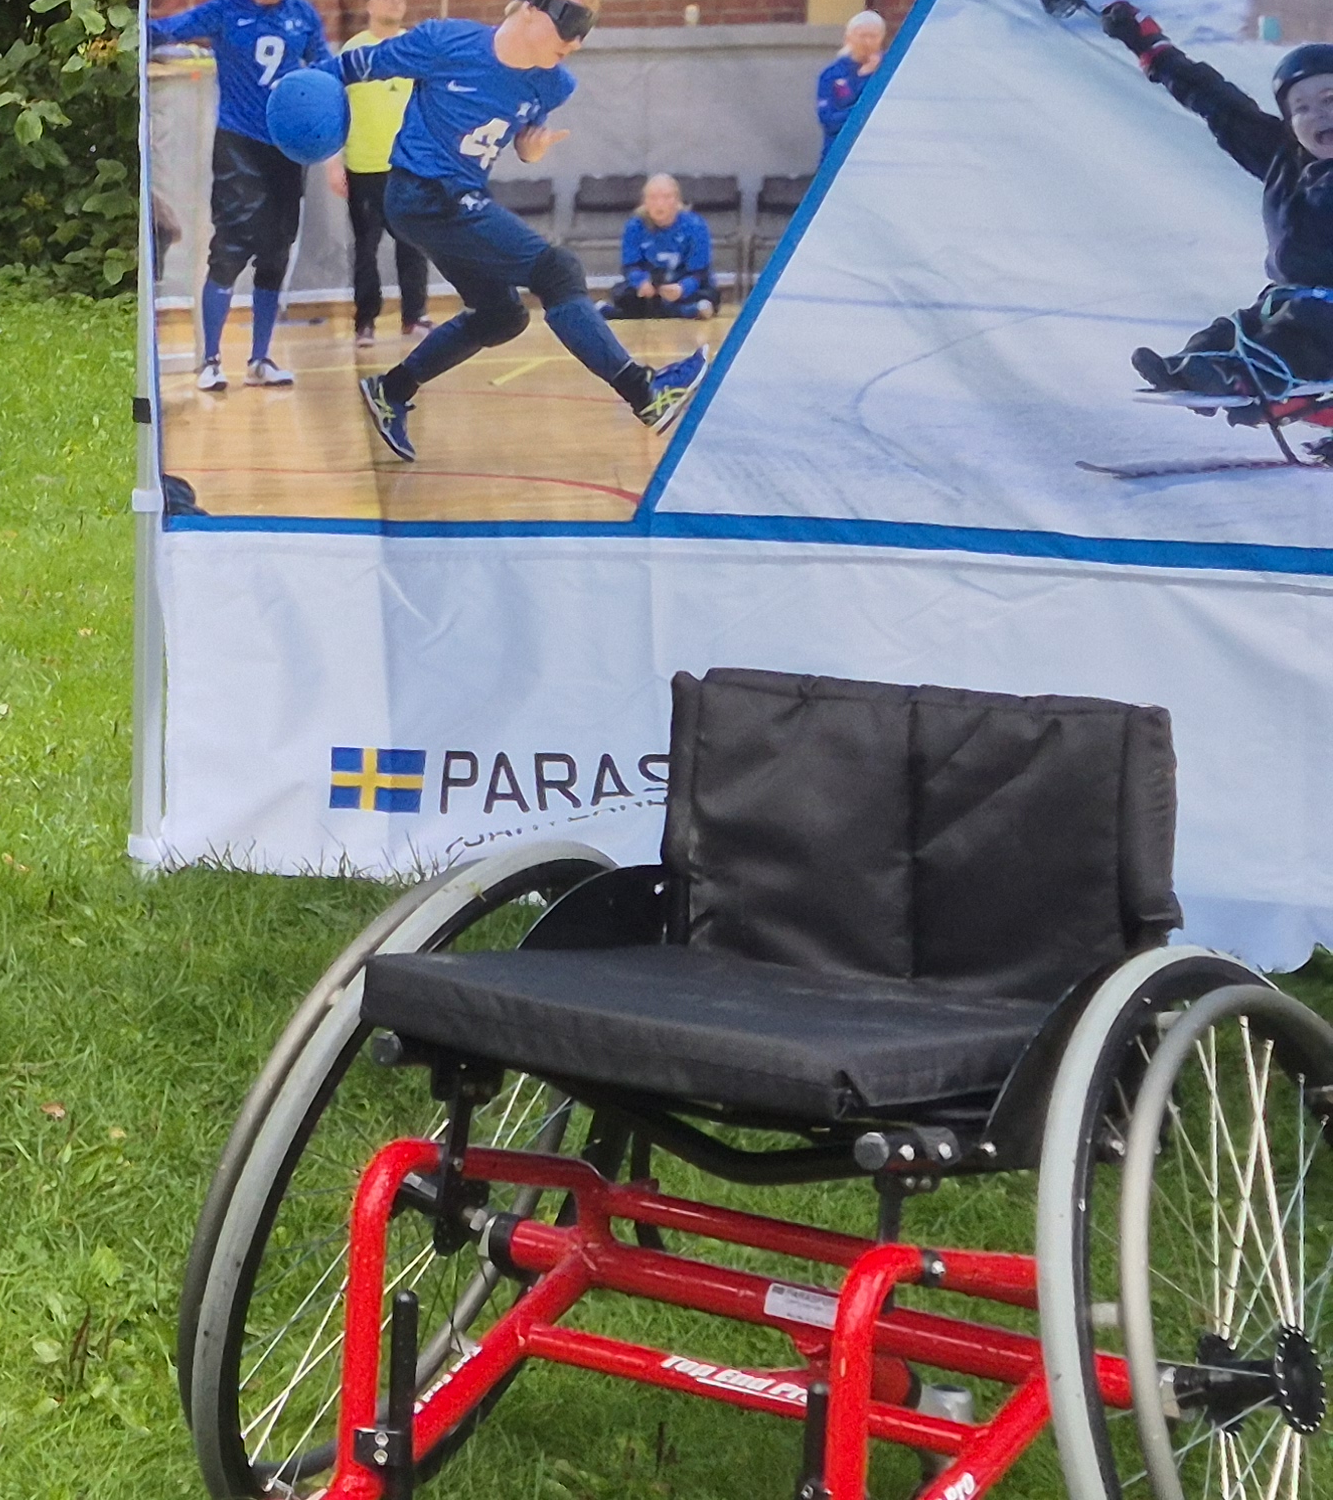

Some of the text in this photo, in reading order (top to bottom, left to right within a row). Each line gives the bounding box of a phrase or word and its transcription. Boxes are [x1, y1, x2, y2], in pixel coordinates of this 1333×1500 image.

[255, 35, 285, 87] 9
[459, 117, 511, 171] 4
[660, 1355, 718, 1379] Top
[713, 1369, 777, 1392] End
